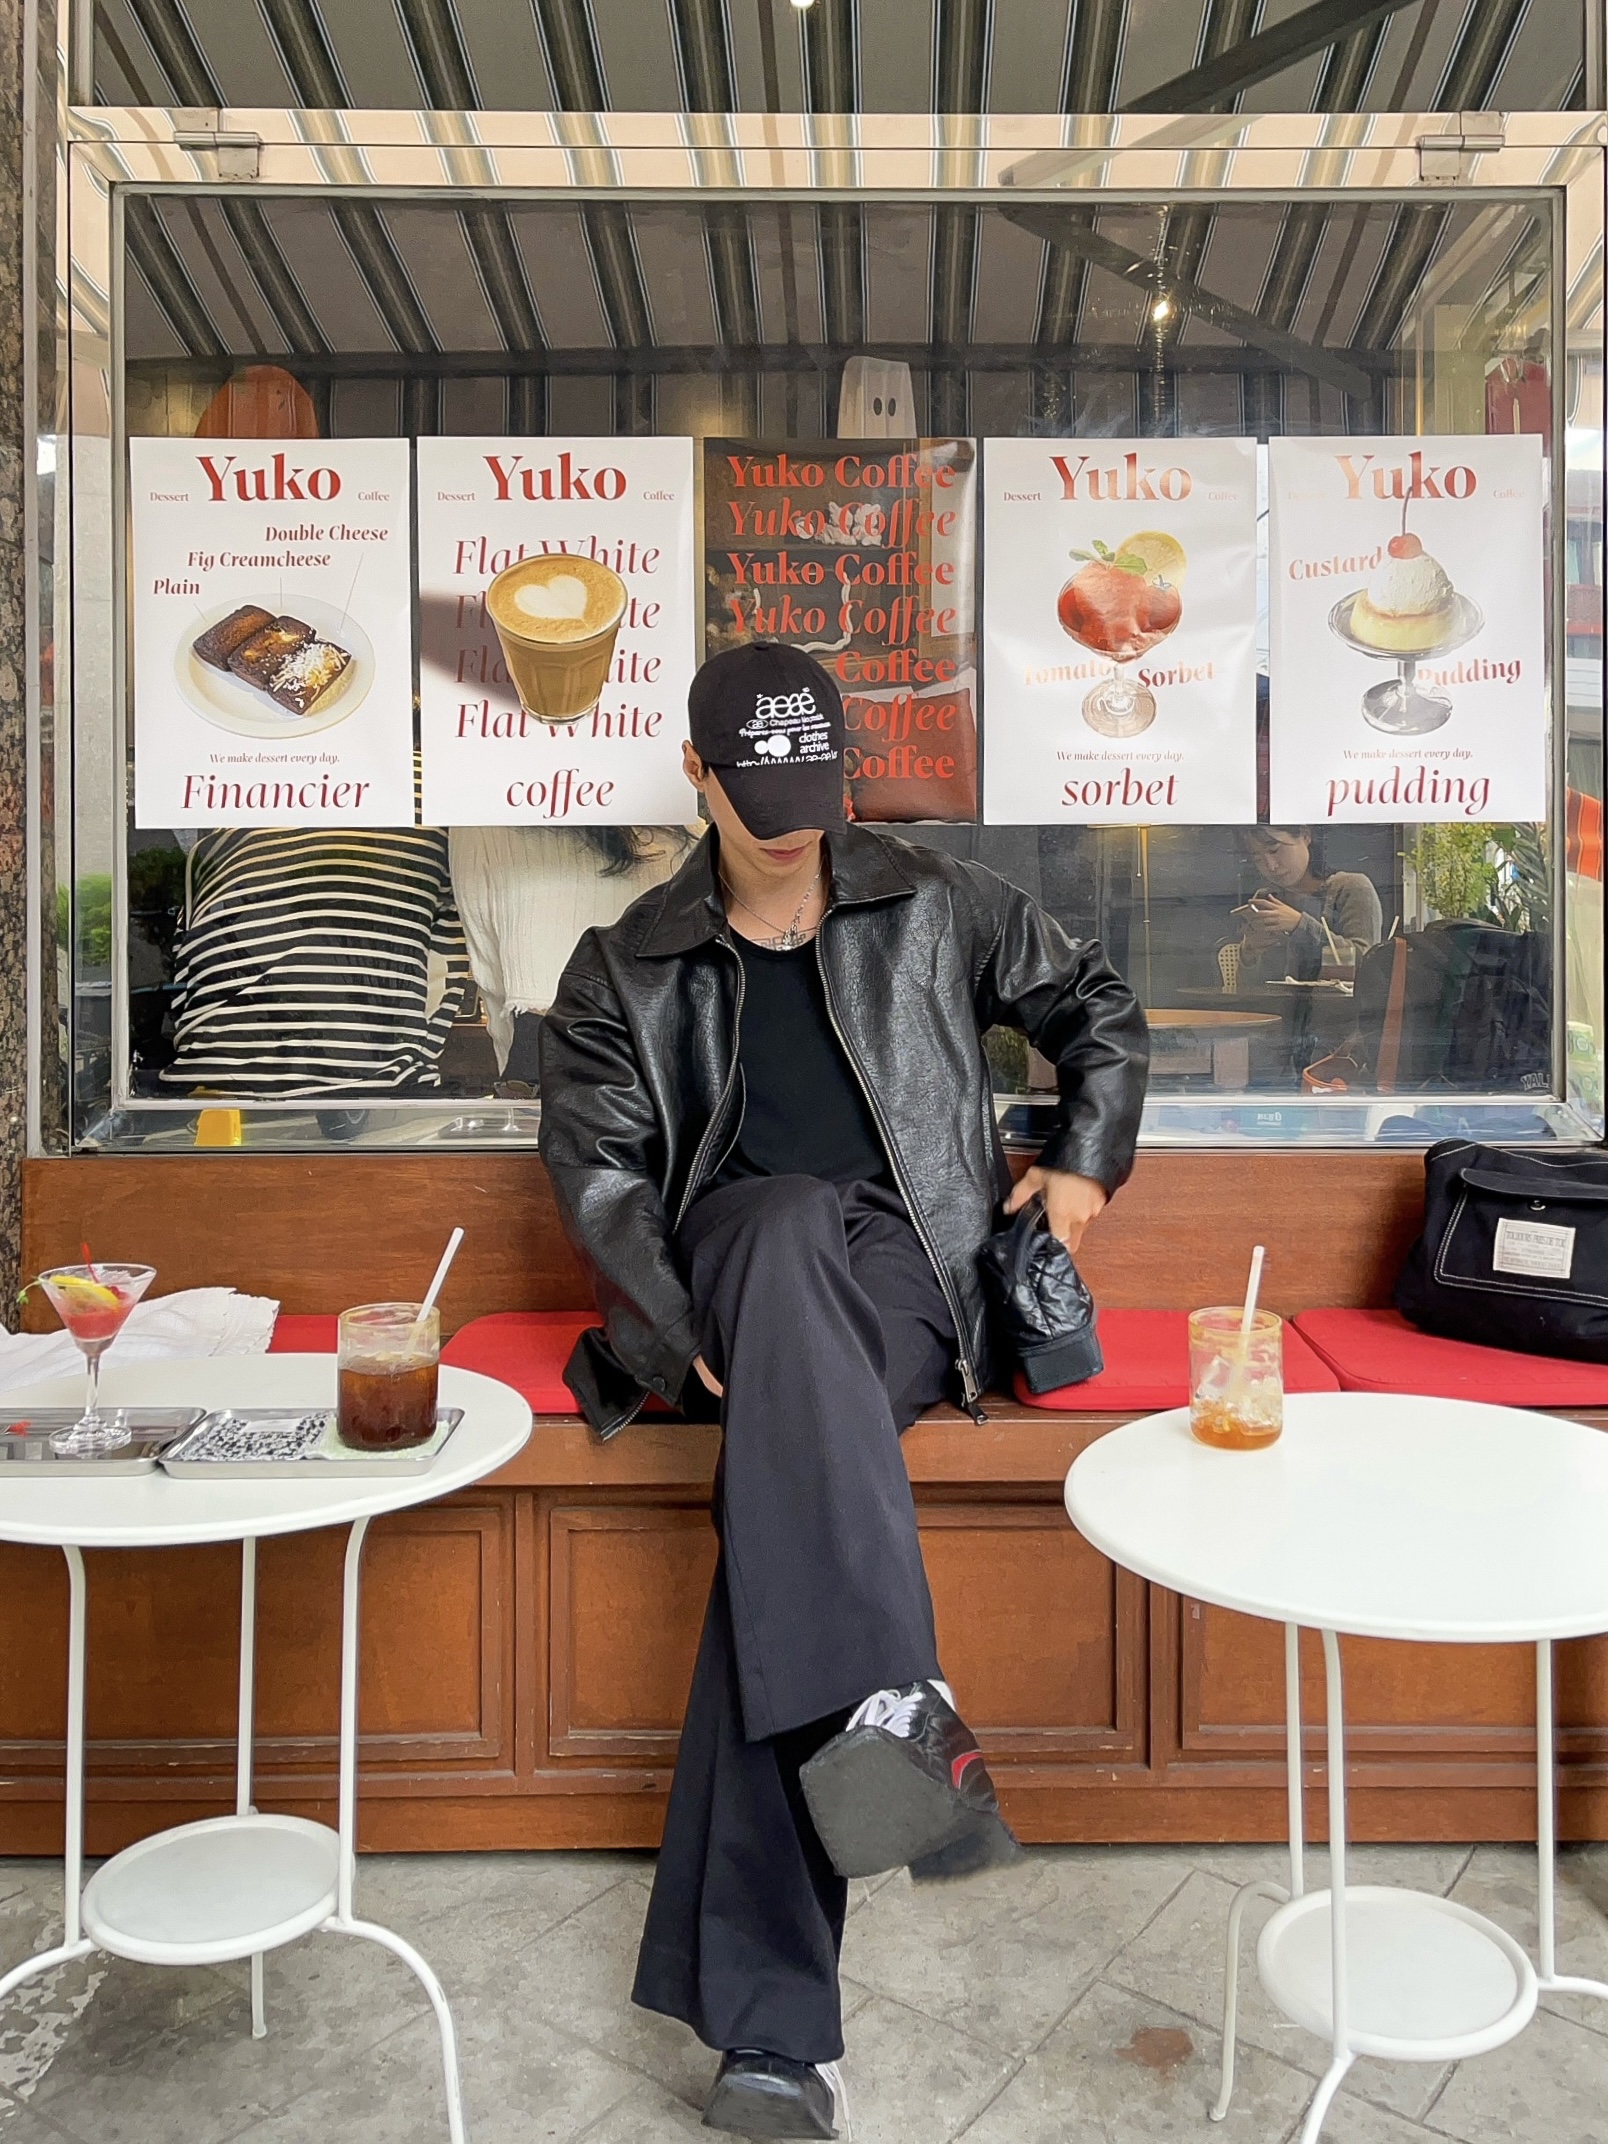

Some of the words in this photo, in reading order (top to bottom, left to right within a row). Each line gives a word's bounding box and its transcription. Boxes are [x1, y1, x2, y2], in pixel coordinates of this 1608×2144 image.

[150, 491, 189, 502] Dessert
[195, 453, 341, 502] Yuko
[358, 491, 390, 502] Coffee
[437, 491, 475, 501] Dessert
[483, 452, 627, 501] Yuko
[643, 490, 675, 501] Coffee
[727, 453, 824, 488] Yuko
[834, 453, 955, 489] Coffee
[1003, 491, 1041, 501] Dessert
[1049, 452, 1192, 501] Yuko
[1334, 451, 1477, 500] Yuko
[265, 525, 324, 541] Double
[329, 524, 388, 541] Cheese
[728, 497, 826, 537] Yuko
[839, 499, 956, 549] Coffee
[187, 551, 214, 571] Fig
[219, 550, 331, 567] Creamcheese
[727, 550, 824, 585] Yuko
[834, 550, 955, 586] Coffee
[1289, 547, 1382, 581] Custard
[153, 578, 200, 595] Plain
[728, 594, 826, 634] Yuko
[838, 596, 956, 646] Coffee
[835, 648, 955, 682] Coffee
[1139, 660, 1215, 688] Sorbet
[455, 699, 531, 738] Flat
[799, 731, 828, 743] clothes
[800, 741, 829, 754] archive
[1343, 750, 1358, 759] We
[1361, 749, 1386, 759] make
[1389, 749, 1422, 759] dessert
[1424, 749, 1450, 760] every
[1453, 748, 1473, 760] day.
[210, 754, 225, 763] We
[228, 753, 253, 763] make
[255, 752, 287, 763] dessert
[290, 755, 317, 765] every
[319, 752, 340, 765] day.
[1056, 751, 1071, 760] We
[1074, 751, 1099, 761] make
[1101, 750, 1133, 761] dessert
[1136, 752, 1161, 763] every
[1164, 750, 1184, 762] day.
[180, 774, 369, 809] Financier
[506, 768, 614, 819] coffee
[1062, 768, 1179, 806] sorbet
[1326, 766, 1490, 817] pudding
